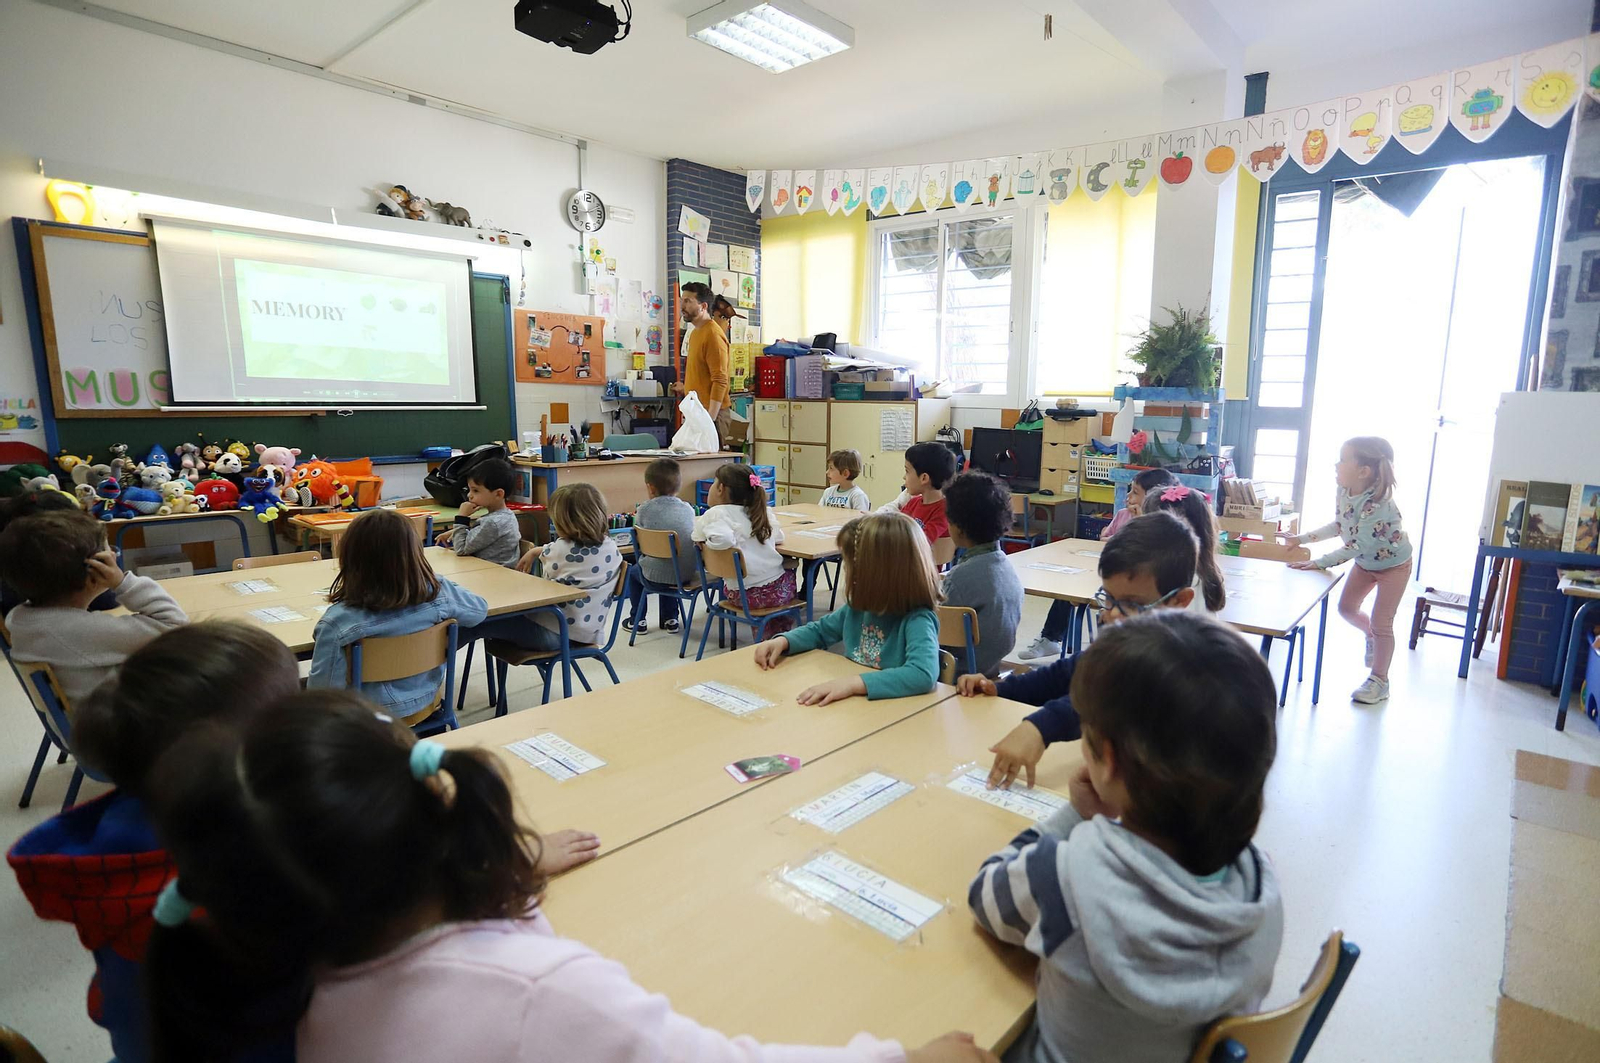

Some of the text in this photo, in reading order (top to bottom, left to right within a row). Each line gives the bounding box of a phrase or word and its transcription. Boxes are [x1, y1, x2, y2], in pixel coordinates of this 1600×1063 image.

[1520, 53, 1542, 81] S
[1454, 70, 1471, 96] R
[1294, 108, 1310, 131] O
[1344, 97, 1362, 122] P
[1203, 127, 1242, 148] N n
[1247, 116, 1287, 142] Ñ ñ
[1158, 134, 1196, 156] M m
[1047, 152, 1055, 168] K
[1084, 148, 1092, 167] L
[870, 170, 877, 186] E
[895, 168, 903, 184] F
[954, 163, 964, 180] H
[584, 193, 591, 203] 12
[572, 205, 578, 214] 9
[597, 210, 602, 219] 3
[585, 222, 590, 230] 6
[252, 299, 348, 321] MEMORY
[91, 323, 148, 350] LOS
[0, 398, 36, 409] ICLA
[551, 738, 588, 762] MANUEL
[809, 782, 862, 811] MARTIN
[961, 785, 1034, 816] CLAUDIO
